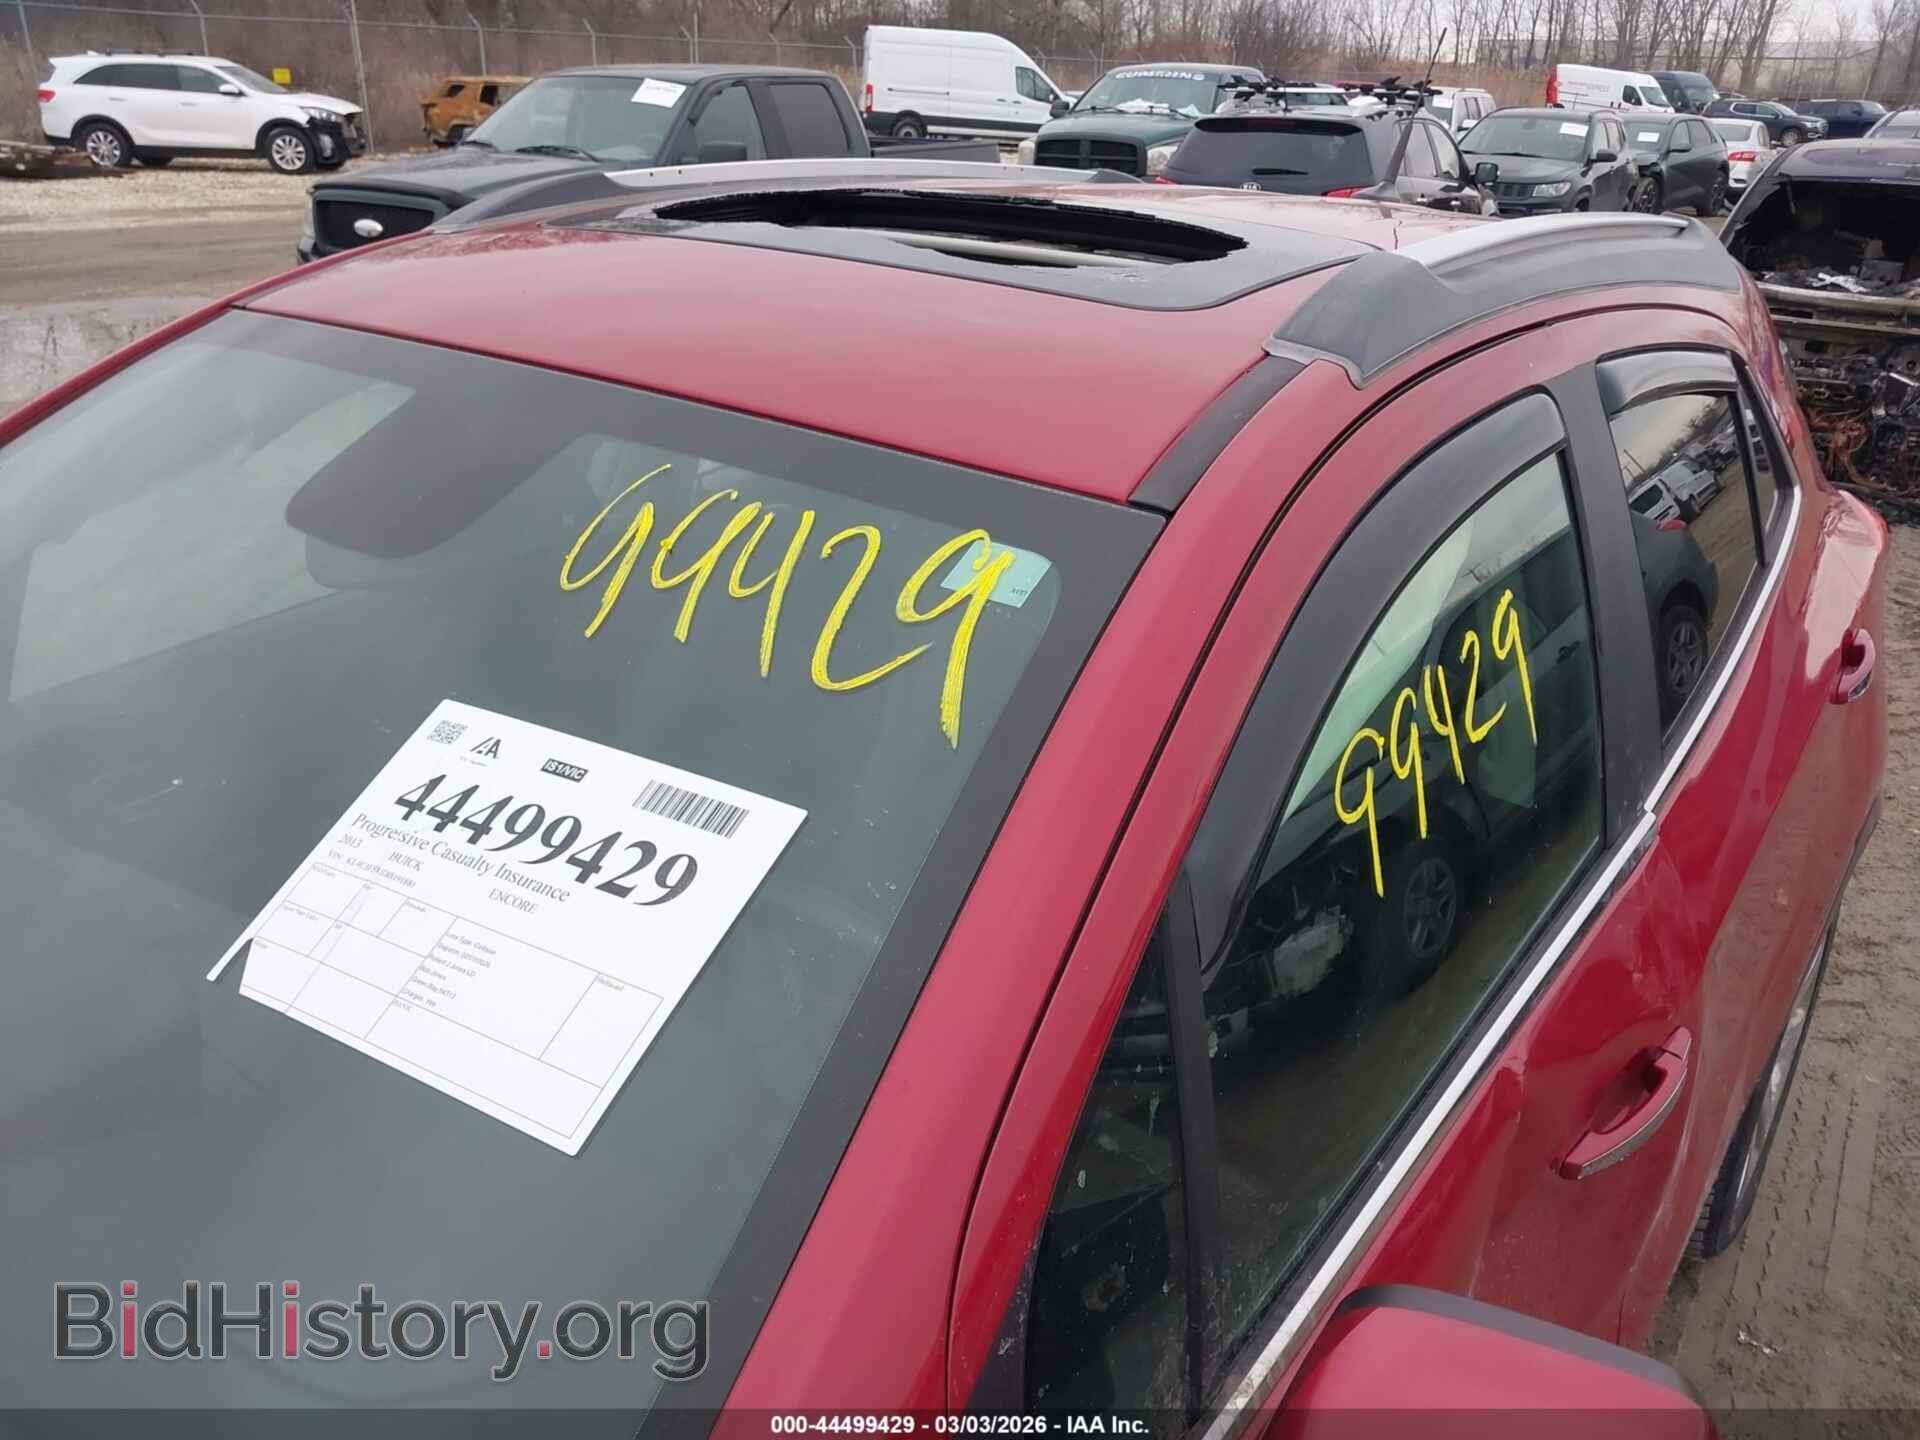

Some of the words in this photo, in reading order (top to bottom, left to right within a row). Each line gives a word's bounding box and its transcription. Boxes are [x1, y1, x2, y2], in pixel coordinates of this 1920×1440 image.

[560, 463, 1015, 749] 99429
[1334, 588, 1538, 898] 99429
[351, 812, 430, 851] Progressive
[431, 839, 493, 877] Casualty
[494, 861, 571, 903] Insurance
[388, 850, 425, 873] BUICK
[488, 888, 540, 915] ENCORE
[394, 774, 698, 906] 44499429
